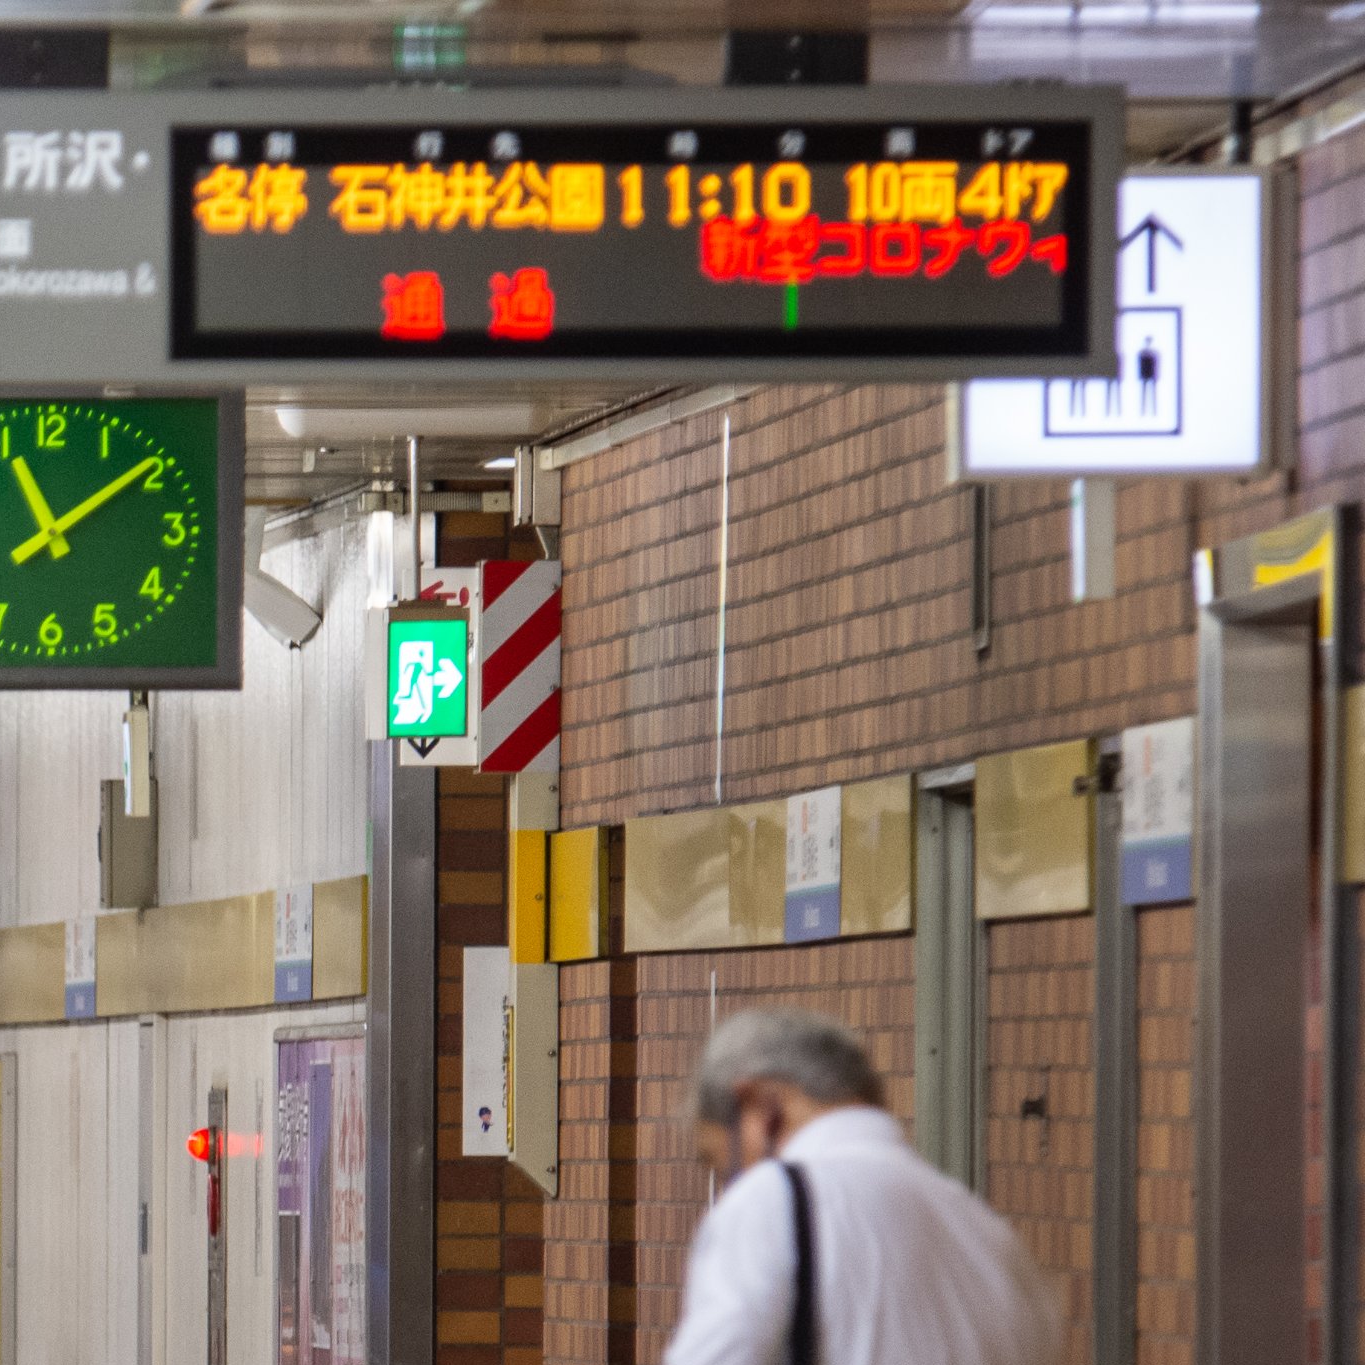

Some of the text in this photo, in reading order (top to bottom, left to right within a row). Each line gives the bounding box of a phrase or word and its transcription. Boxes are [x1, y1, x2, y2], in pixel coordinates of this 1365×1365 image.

[36, 414, 66, 448] 12
[100, 425, 109, 460] 1
[142, 457, 165, 491] 2
[162, 511, 187, 547] 3
[139, 566, 165, 602] 4
[39, 612, 64, 647] 6
[92, 603, 117, 638] 5
